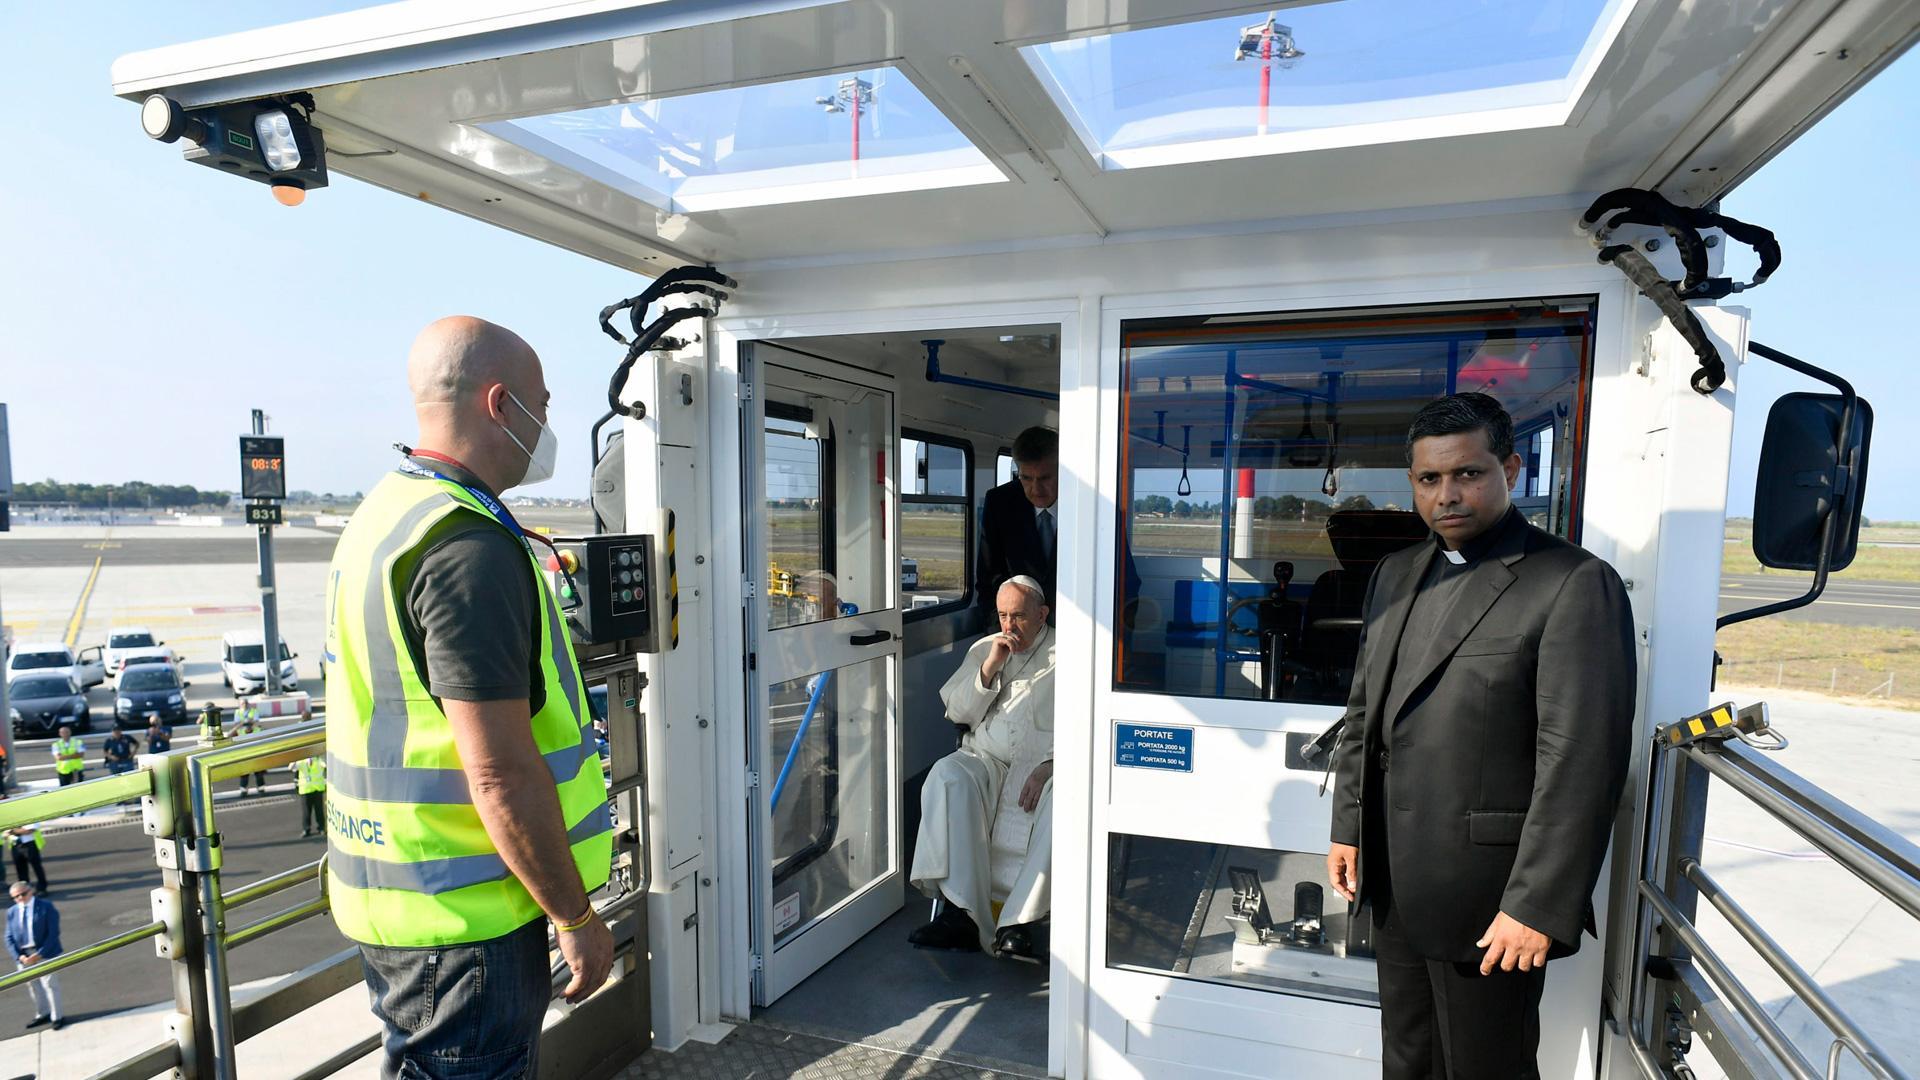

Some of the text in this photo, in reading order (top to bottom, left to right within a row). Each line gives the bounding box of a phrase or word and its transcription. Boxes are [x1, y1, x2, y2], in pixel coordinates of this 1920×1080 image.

[252, 509, 276, 520] 831
[1134, 729, 1173, 739] PORTATE
[1137, 741, 1164, 749] PORTATA
[1164, 743, 1178, 751] 2000
[1179, 745, 1186, 753] kg
